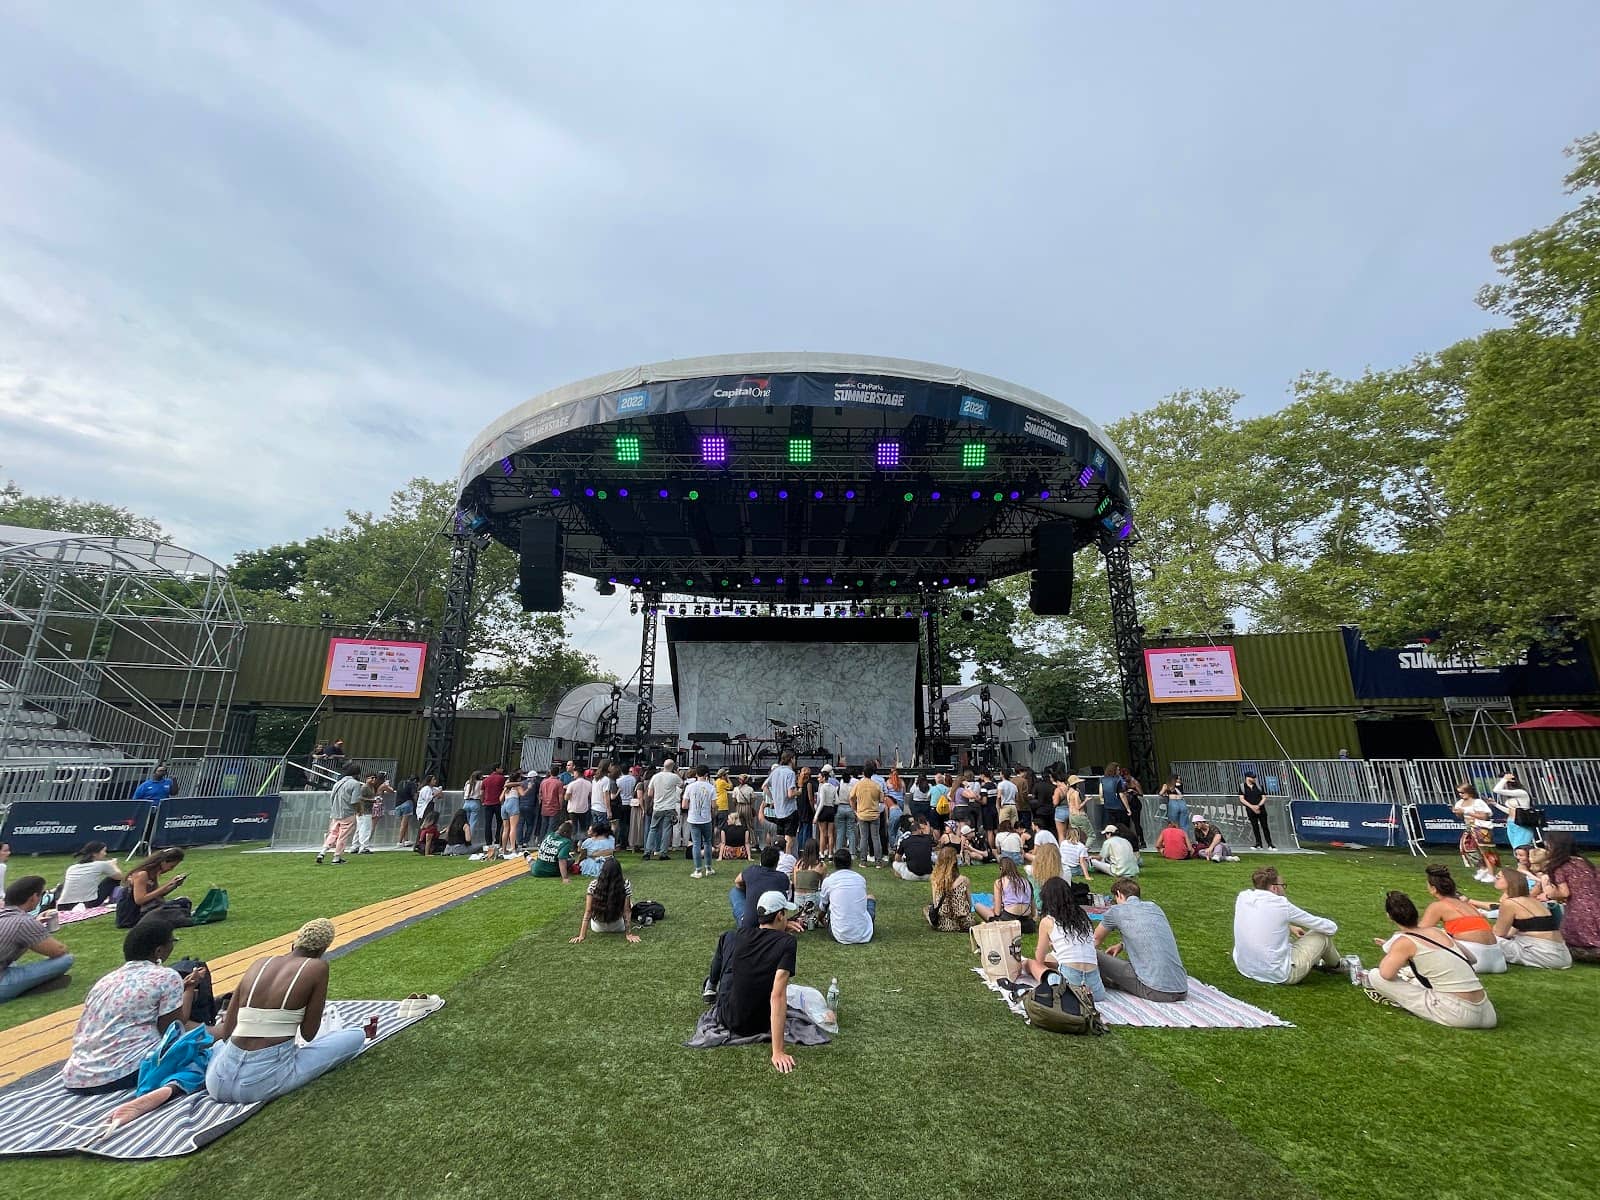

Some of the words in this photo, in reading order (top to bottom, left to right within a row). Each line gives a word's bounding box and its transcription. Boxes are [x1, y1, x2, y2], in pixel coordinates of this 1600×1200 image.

[621, 395, 643, 409] 2022
[834, 389, 905, 407] SUMMERSTAGE
[963, 400, 984, 415] 2022
[1024, 421, 1069, 447] SUMMERSTAGE
[12, 825, 78, 834] SUMMERSTAGE
[163, 818, 219, 828] SUMMERSTAGE
